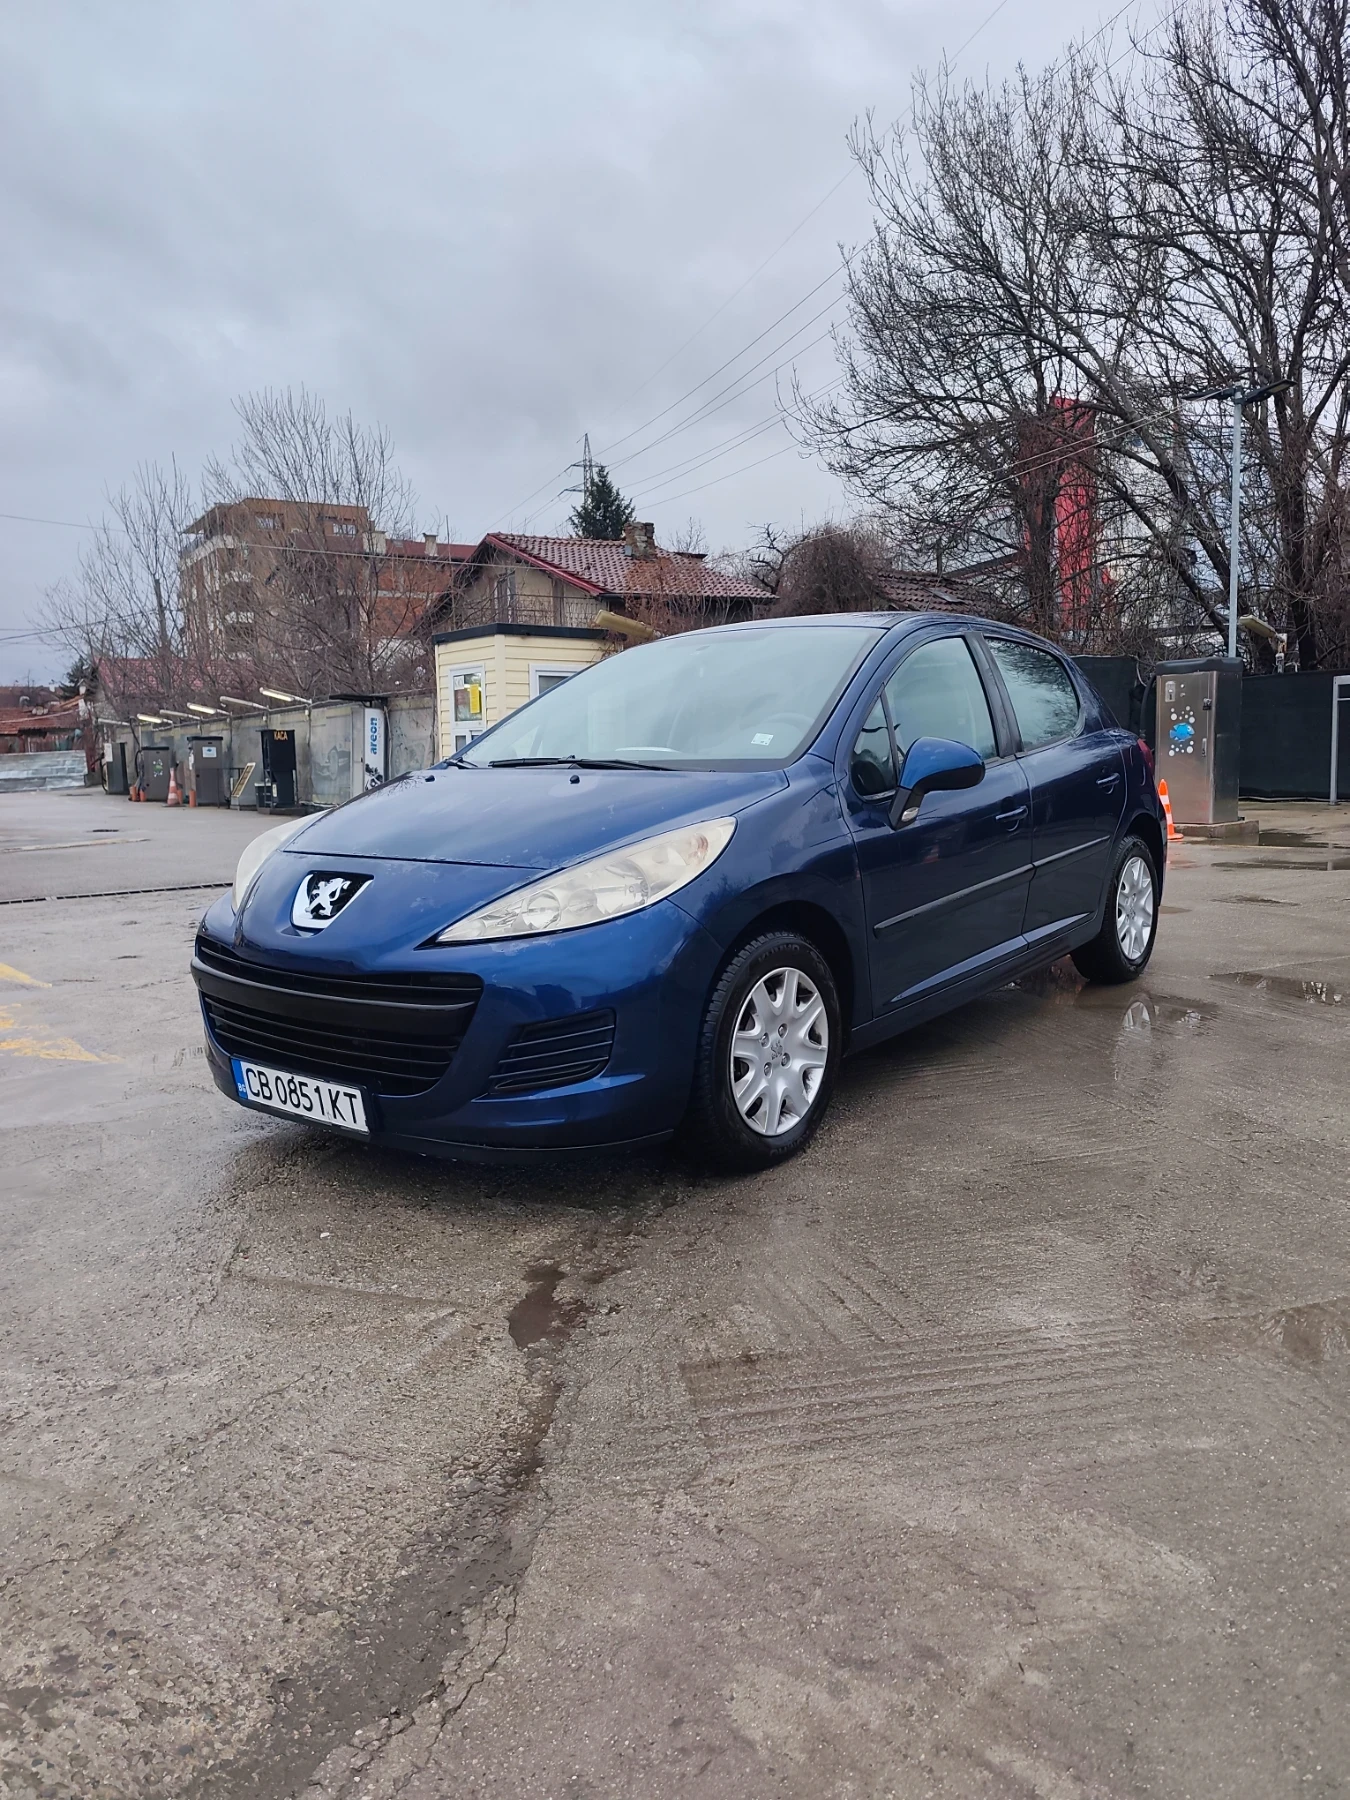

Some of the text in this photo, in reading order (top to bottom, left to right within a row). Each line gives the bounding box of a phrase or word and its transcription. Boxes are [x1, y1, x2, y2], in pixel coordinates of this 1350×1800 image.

[370, 717, 378, 755] areon
[238, 1083, 247, 1092] BG
[275, 1075, 326, 1116] 0851
